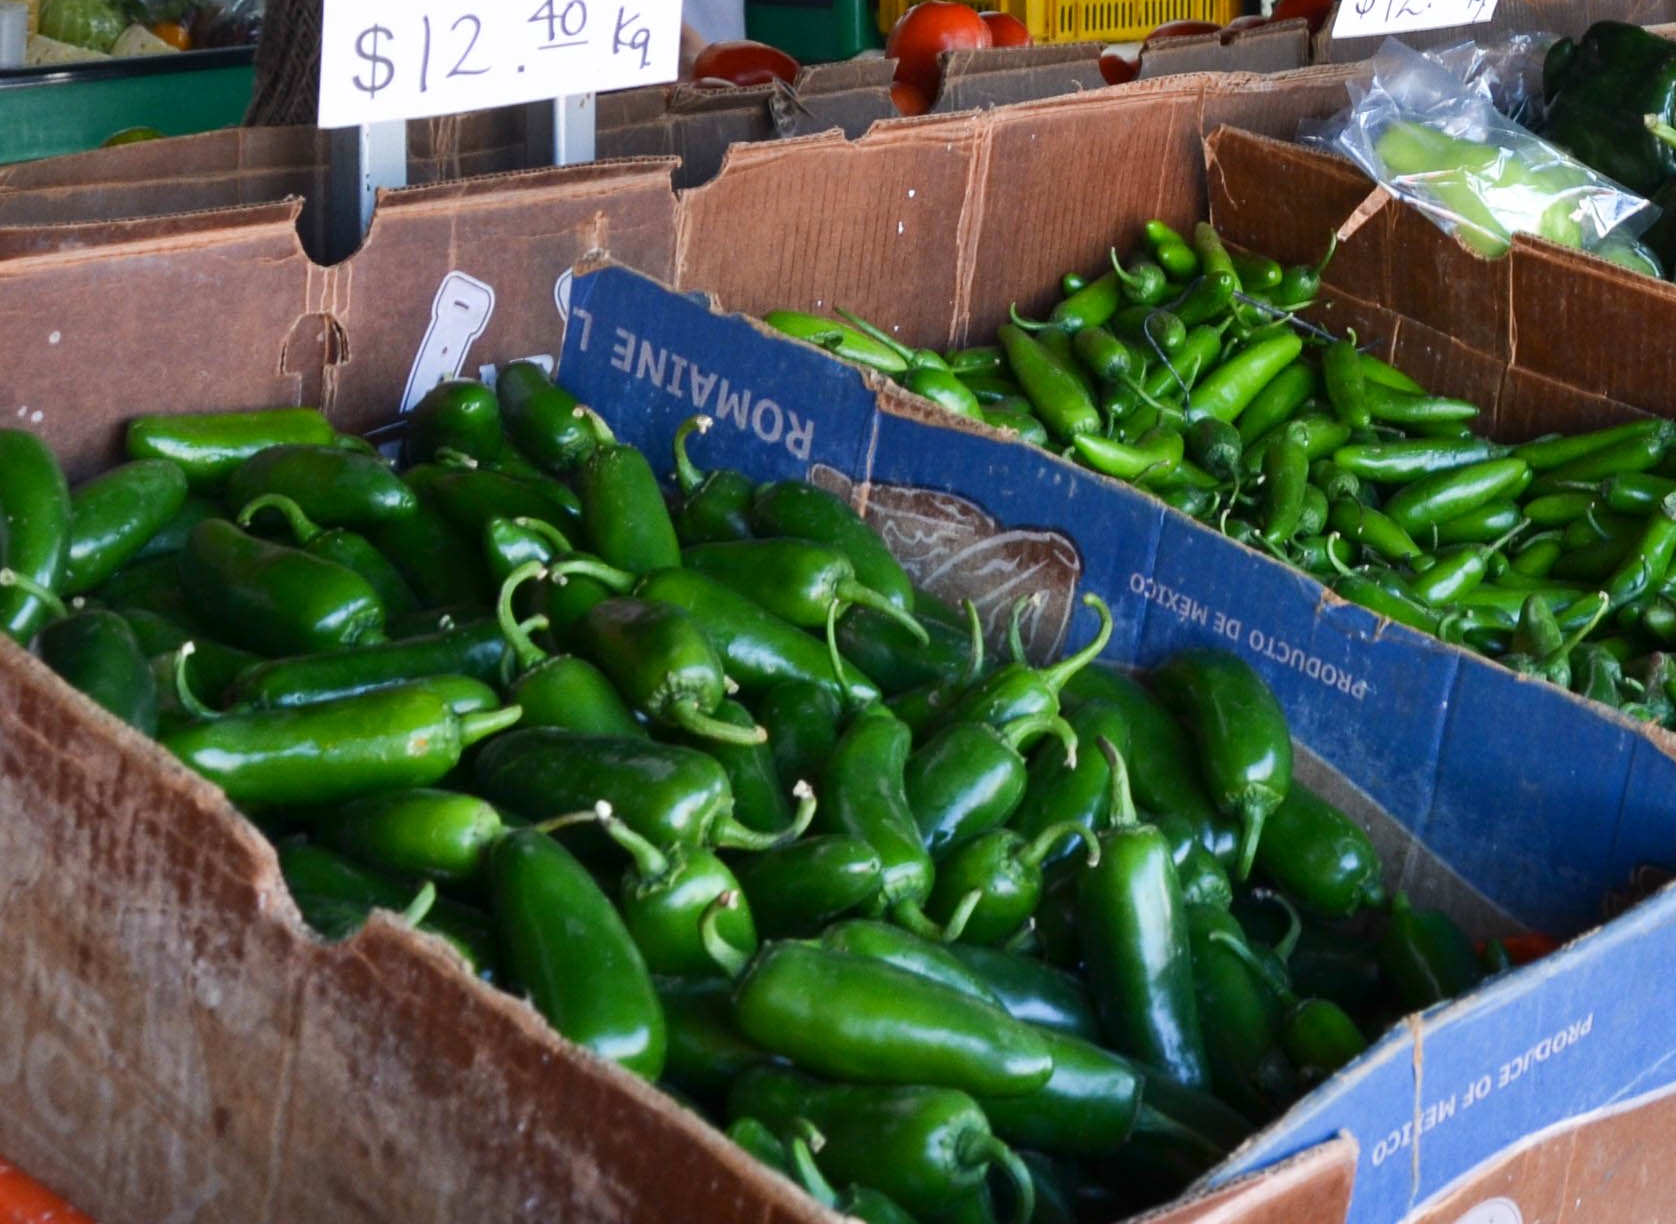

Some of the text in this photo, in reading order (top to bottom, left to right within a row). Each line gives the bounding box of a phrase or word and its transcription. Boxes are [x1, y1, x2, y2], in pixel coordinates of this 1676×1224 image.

[609, 327, 816, 460] ROMAINE
[1213, 611, 1242, 640] DE
[1249, 629, 1367, 700] PRODUCTO
[1498, 1013, 1593, 1089] PRODUCE
[1462, 1074, 1491, 1110] OF
